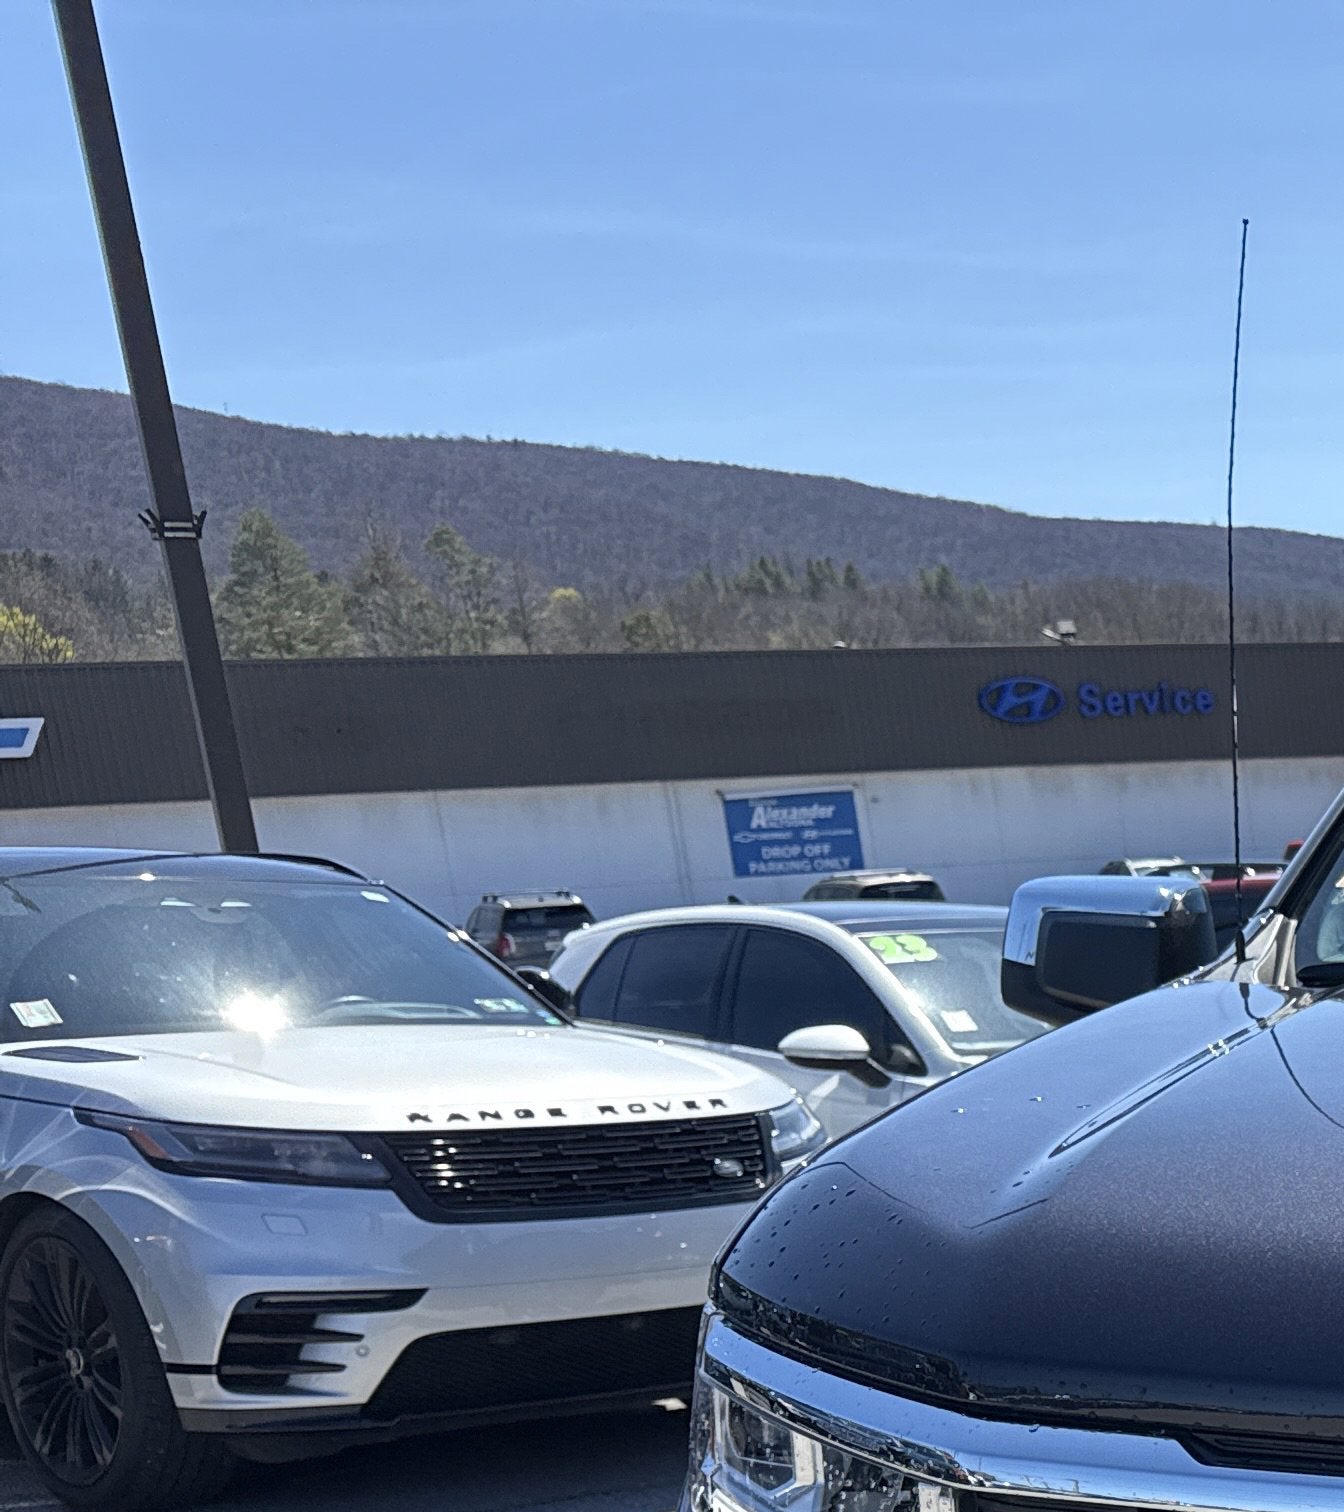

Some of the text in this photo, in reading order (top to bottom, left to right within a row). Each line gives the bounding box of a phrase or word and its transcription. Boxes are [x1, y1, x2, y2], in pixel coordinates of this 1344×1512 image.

[1078, 681, 1214, 719] Service
[751, 803, 836, 828] Alexander
[762, 842, 831, 859] DROP OFF
[749, 856, 850, 874] PARKING ONLY
[869, 934, 938, 964] 23
[407, 1098, 727, 1123] RANGE ROVER
